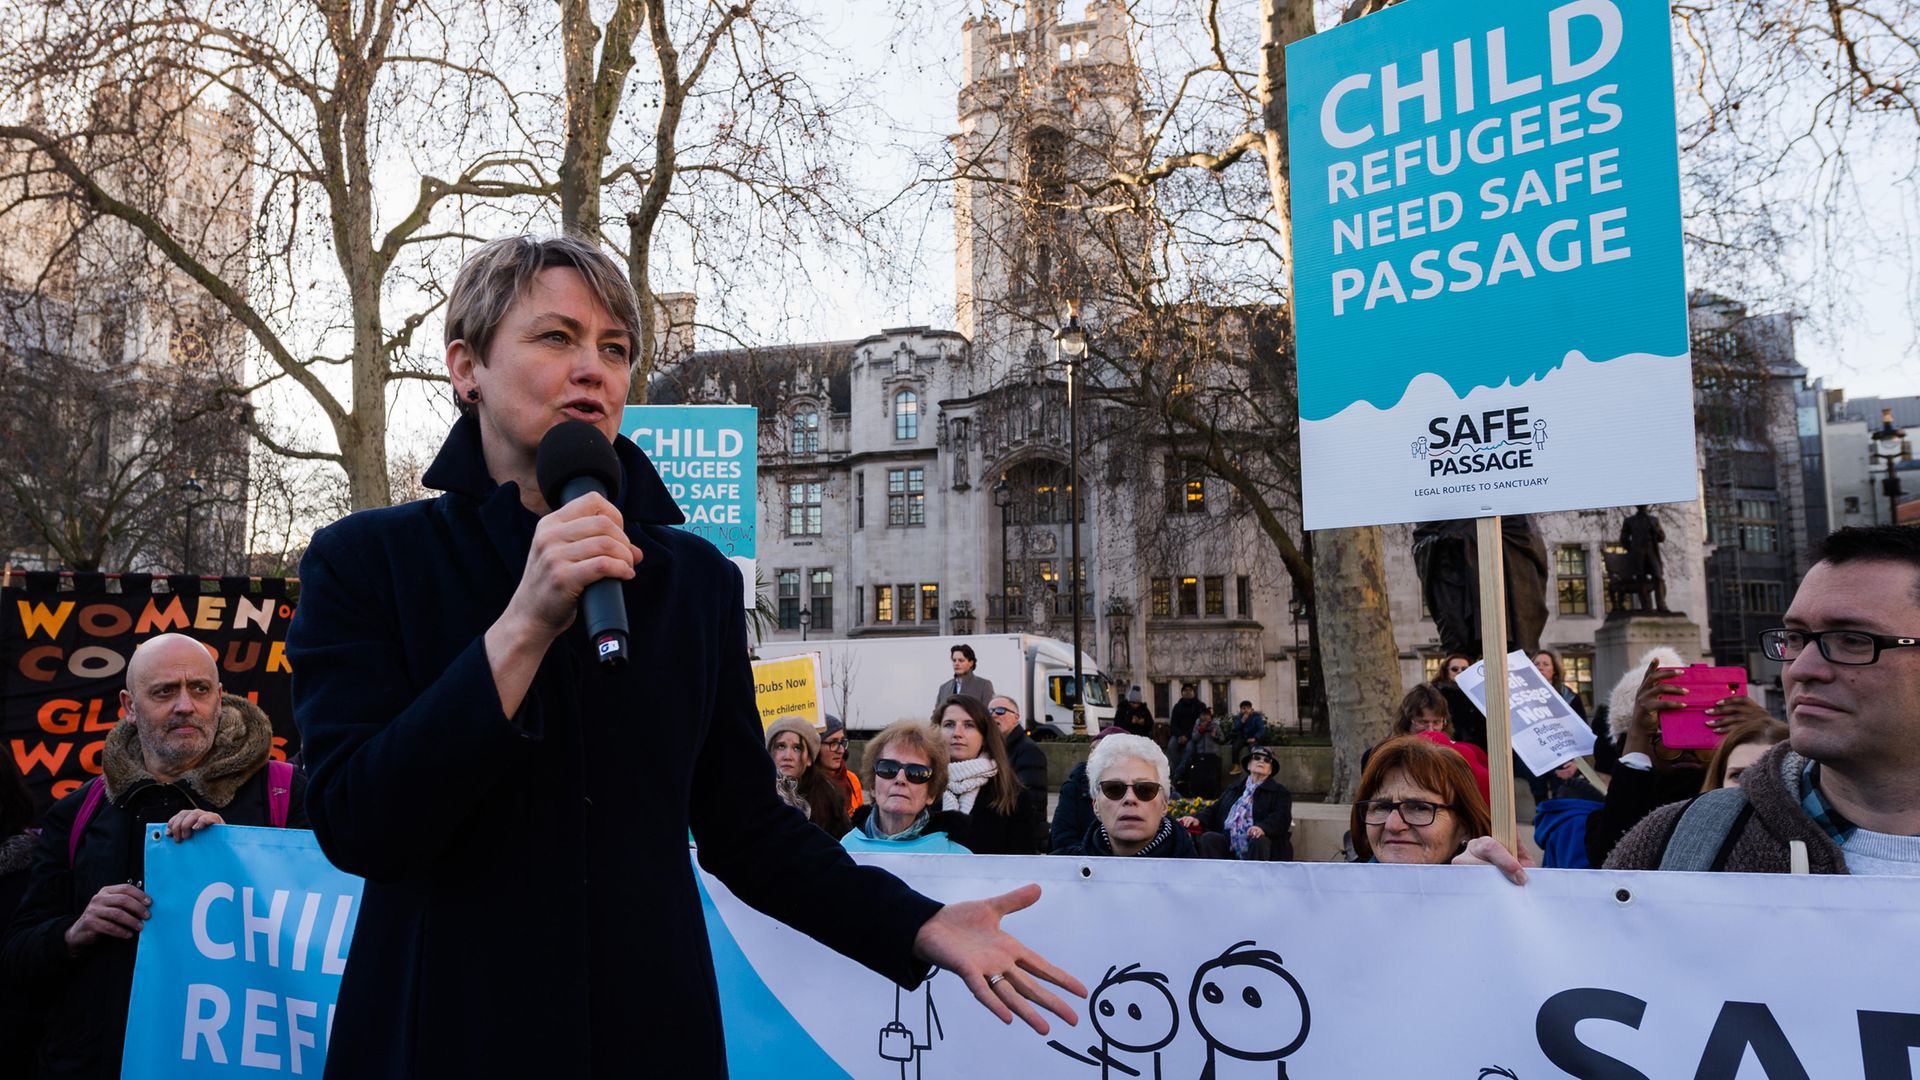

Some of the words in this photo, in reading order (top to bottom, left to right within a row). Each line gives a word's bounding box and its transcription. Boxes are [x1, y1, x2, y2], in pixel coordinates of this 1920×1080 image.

[1320, 0, 1623, 149] CHILD
[1328, 84, 1622, 204] REFUGEES
[1333, 191, 1463, 255] NEED
[1480, 148, 1622, 220] SAFE
[1332, 207, 1631, 316] PASSAGE
[1428, 406, 1532, 450] SAFE
[630, 428, 743, 458] CHILD
[654, 461, 742, 478] FUGEES
[1430, 449, 1533, 477] PASSAGE
[690, 483, 740, 499] SAFE
[1414, 485, 1441, 497] LEGAL
[1442, 484, 1476, 494] ROUTES
[1479, 483, 1491, 491] TO
[1494, 477, 1549, 490] SANCTUARY
[680, 504, 742, 524] SAGE
[17, 595, 276, 640] WOMEN
[785, 678, 807, 689] Now
[762, 708, 775, 717] the
[776, 703, 806, 714] children
[808, 700, 815, 708] in
[1516, 706, 1554, 725] Now
